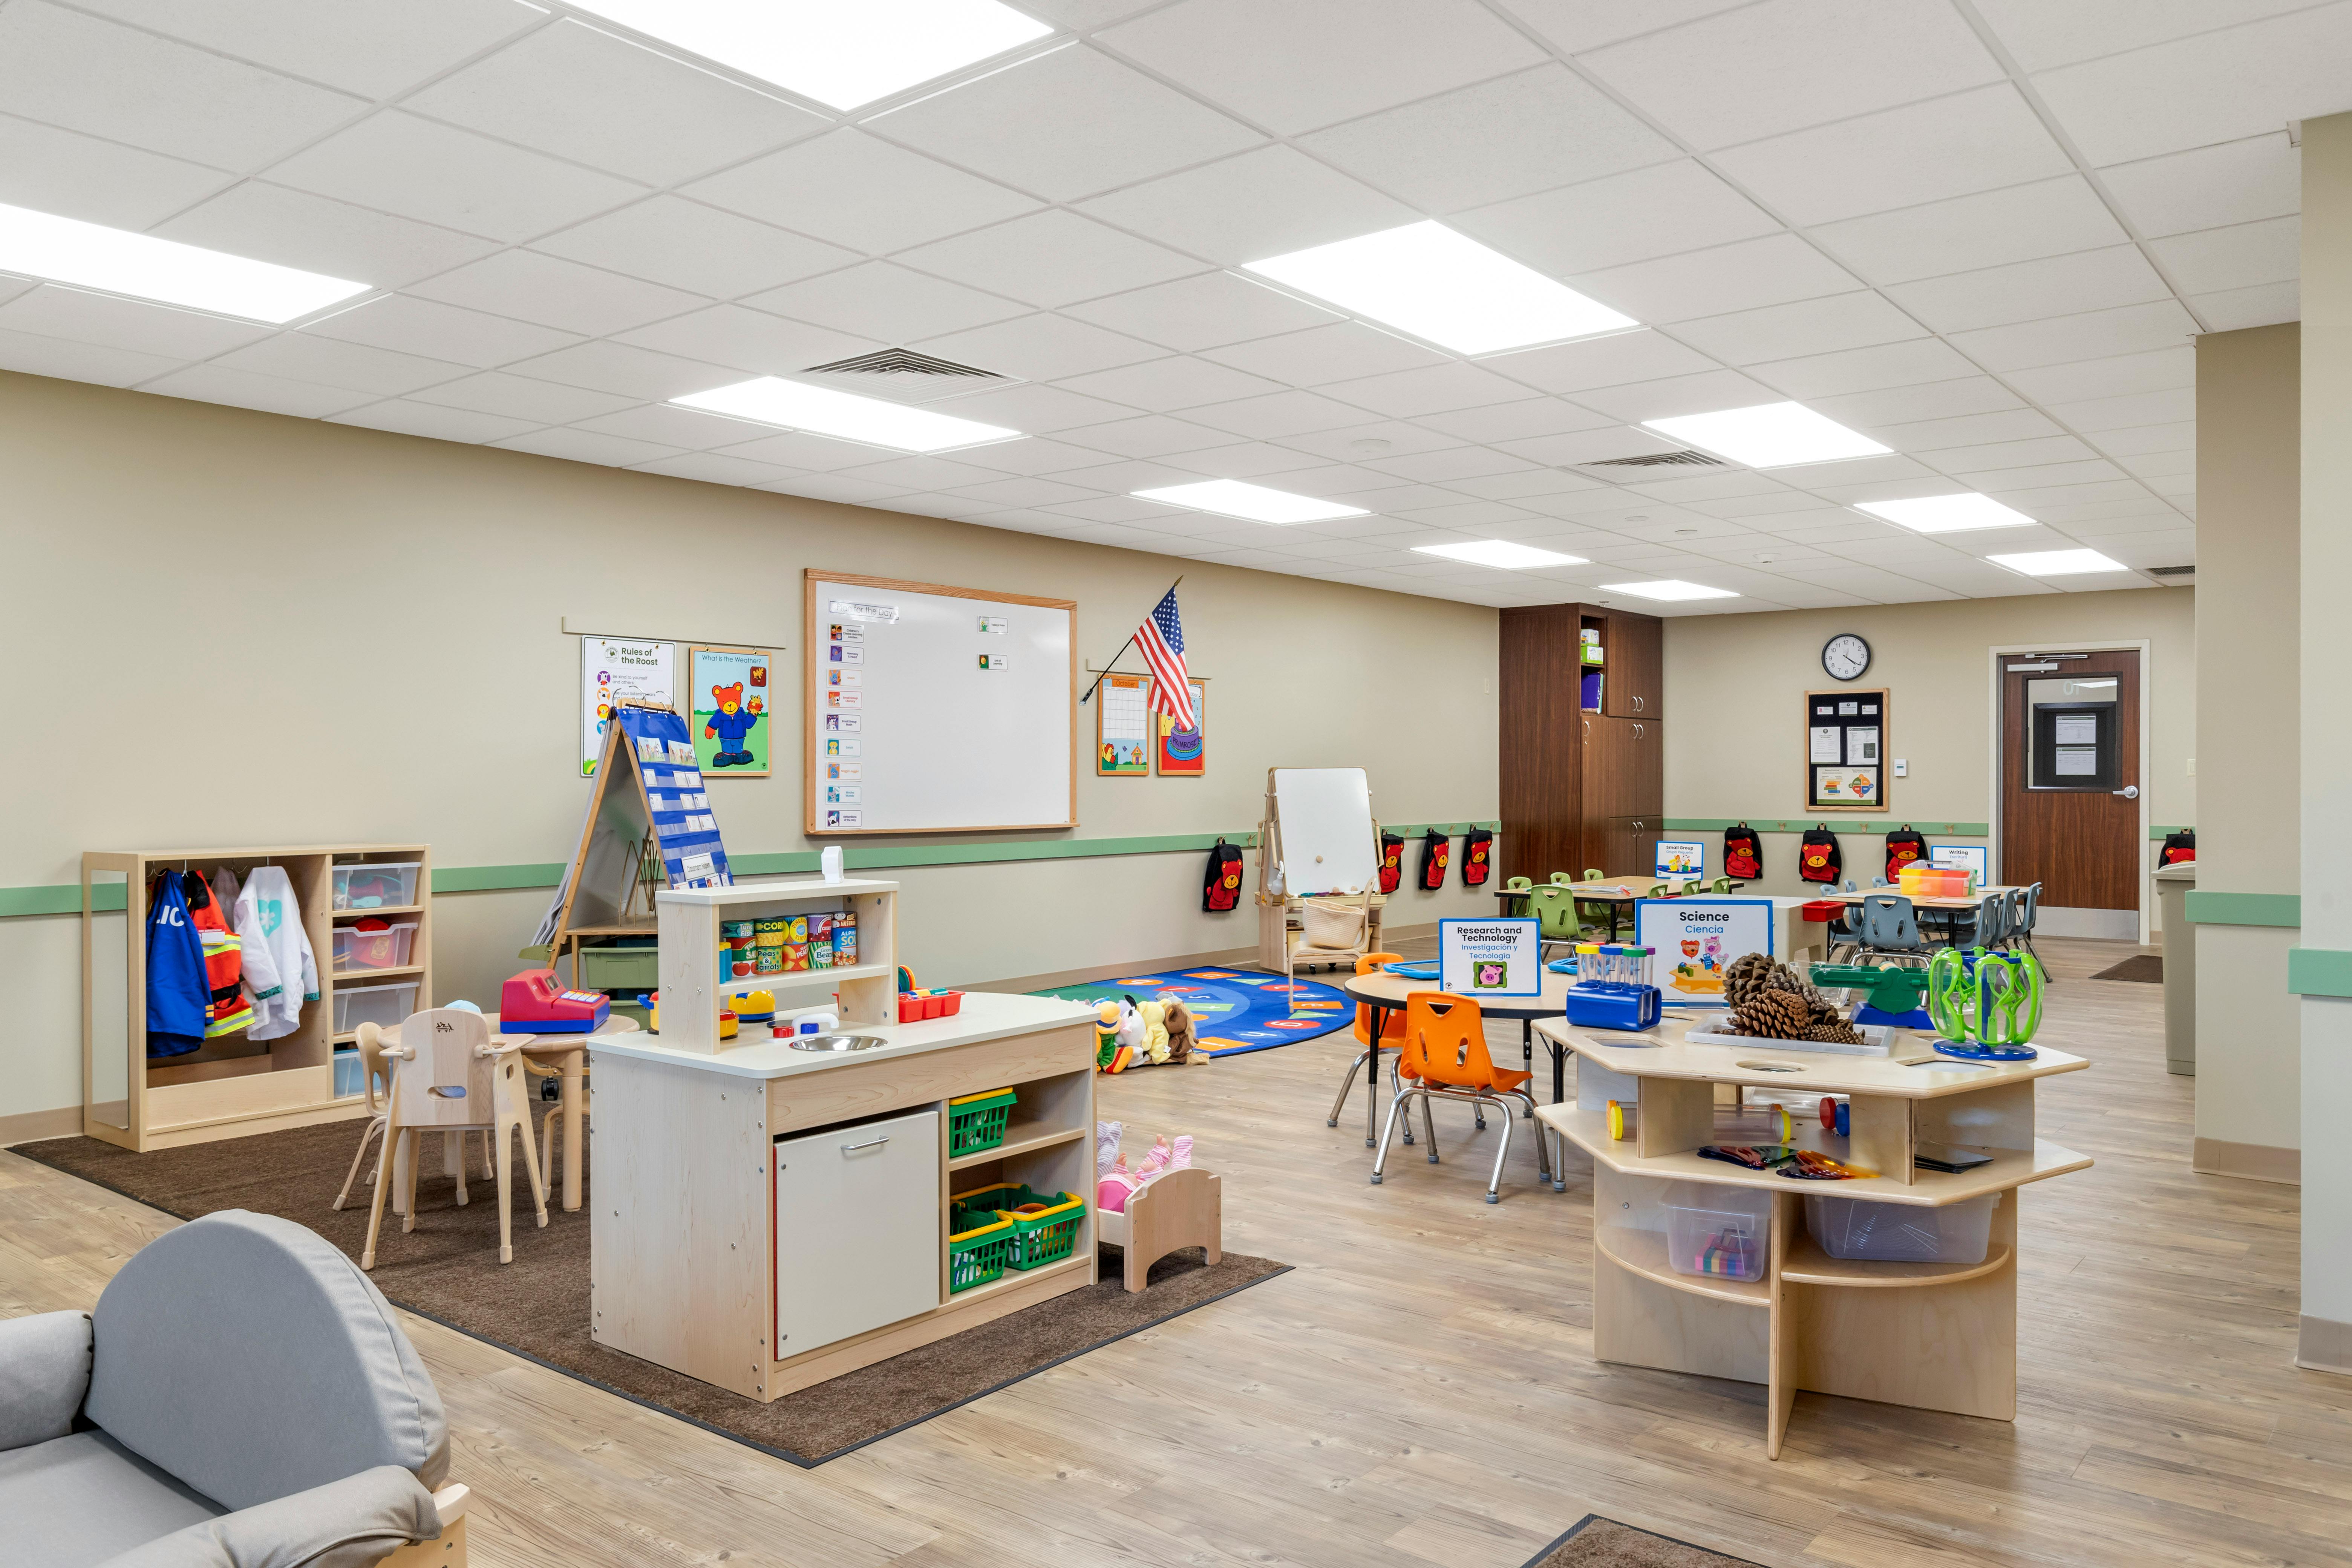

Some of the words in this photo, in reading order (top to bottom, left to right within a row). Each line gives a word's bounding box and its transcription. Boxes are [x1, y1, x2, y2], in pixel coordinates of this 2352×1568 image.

[879, 609, 893, 617] Day
[1680, 911, 1729, 921] Science
[1462, 934, 1517, 944] Technology
